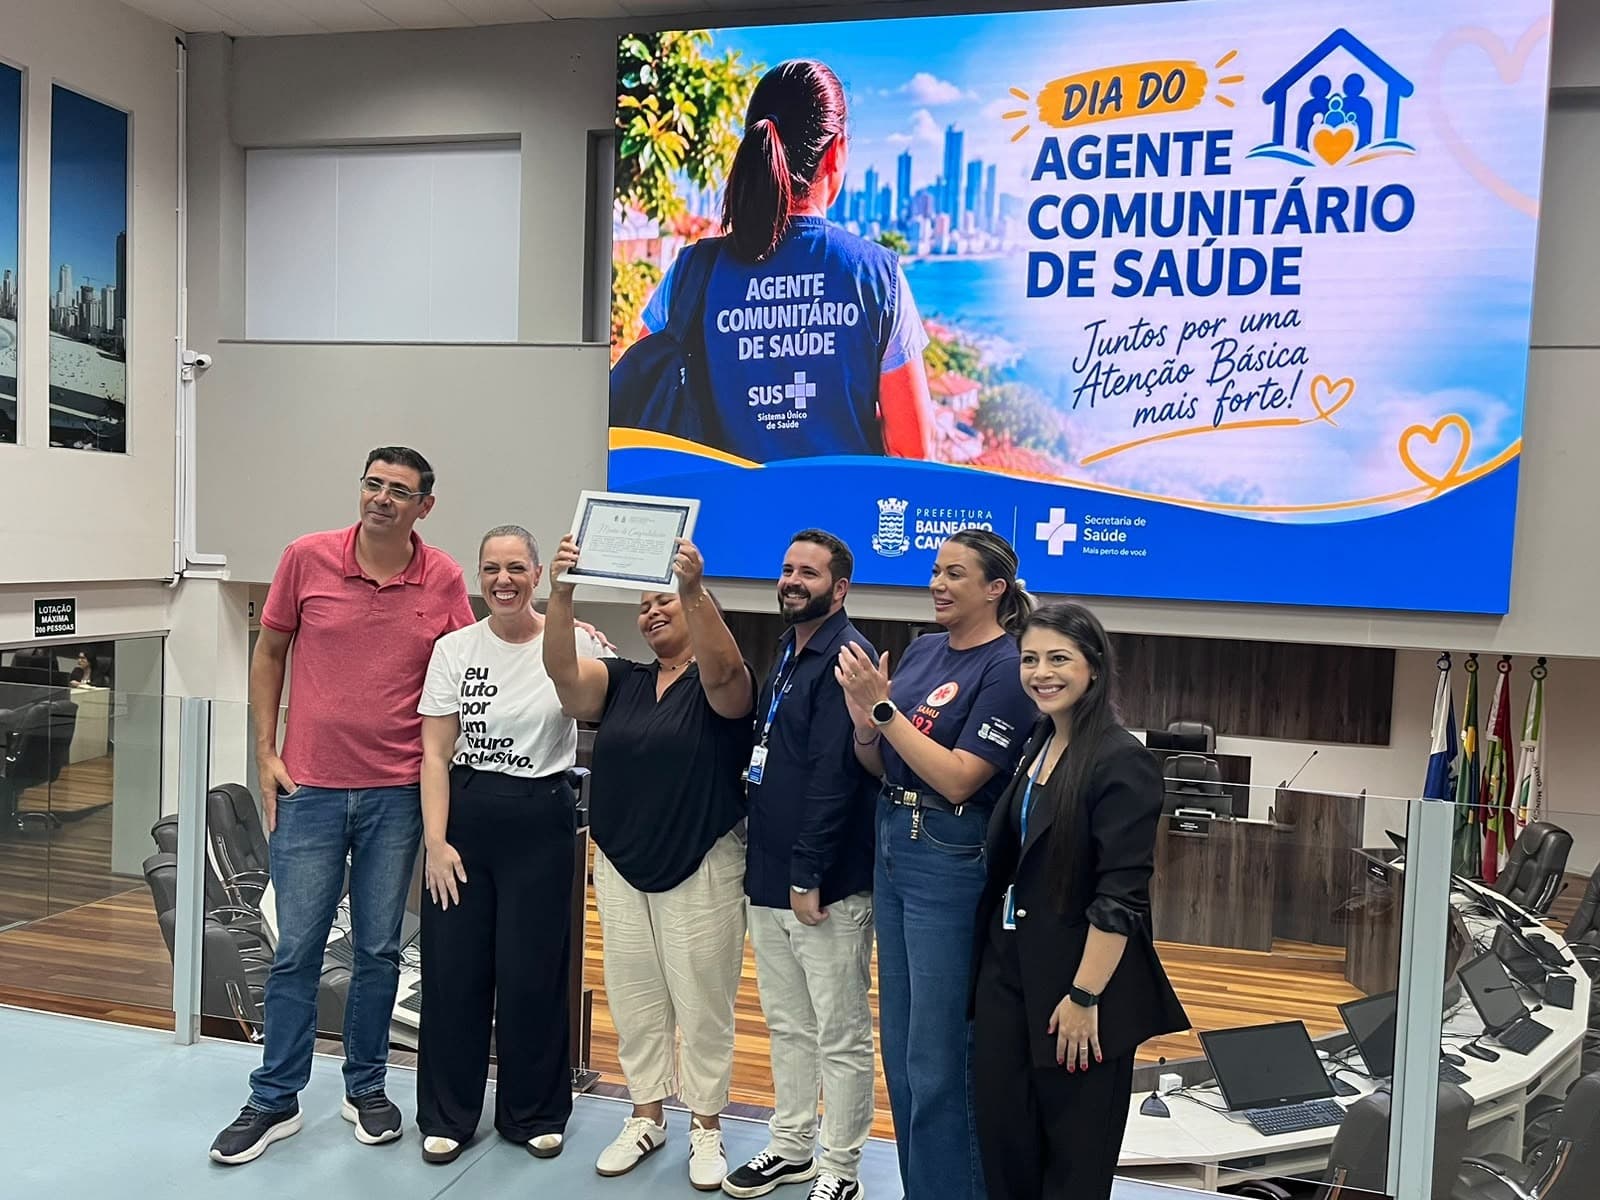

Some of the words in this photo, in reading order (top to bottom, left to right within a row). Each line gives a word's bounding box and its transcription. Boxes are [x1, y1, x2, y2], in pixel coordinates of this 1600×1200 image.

[1062, 76, 1123, 121] DIA
[1137, 68, 1186, 110] DO
[1030, 129, 1234, 182] AGENTE
[1027, 176, 1416, 240] COMUNITÁRIO
[1026, 250, 1096, 298] DE
[1111, 237, 1303, 298] SAÚDE
[745, 273, 825, 301] AGENTE
[716, 298, 859, 333] COMUNITÁRIO
[738, 336, 764, 360] DE
[769, 328, 836, 359] SAÚDE
[1072, 317, 1169, 374] Juntos
[1176, 315, 1227, 355] por
[1239, 308, 1302, 334] uma
[1072, 360, 1196, 410] Atenção
[1206, 337, 1310, 387] Básica
[748, 385, 783, 406] SUS
[1132, 392, 1199, 428] mais
[1213, 369, 1304, 428] forte!
[757, 412, 786, 422] Sistema
[766, 421, 776, 430] de
[916, 508, 993, 520] PREFEITURA
[1084, 514, 1132, 526] Secretaria
[1134, 516, 1147, 527] de
[1083, 528, 1127, 542] Saúde
[1082, 546, 1099, 555] Mais
[1100, 548, 1119, 556] perto
[1120, 548, 1129, 556] de
[38, 603, 72, 615] LOTAÇÃO
[41, 613, 70, 624] MÁXIMA
[46, 623, 74, 633] PESSOAS
[464, 667, 489, 680] eu
[460, 681, 498, 697] luto
[462, 701, 491, 720] por
[456, 750, 534, 769] nclusivo.
